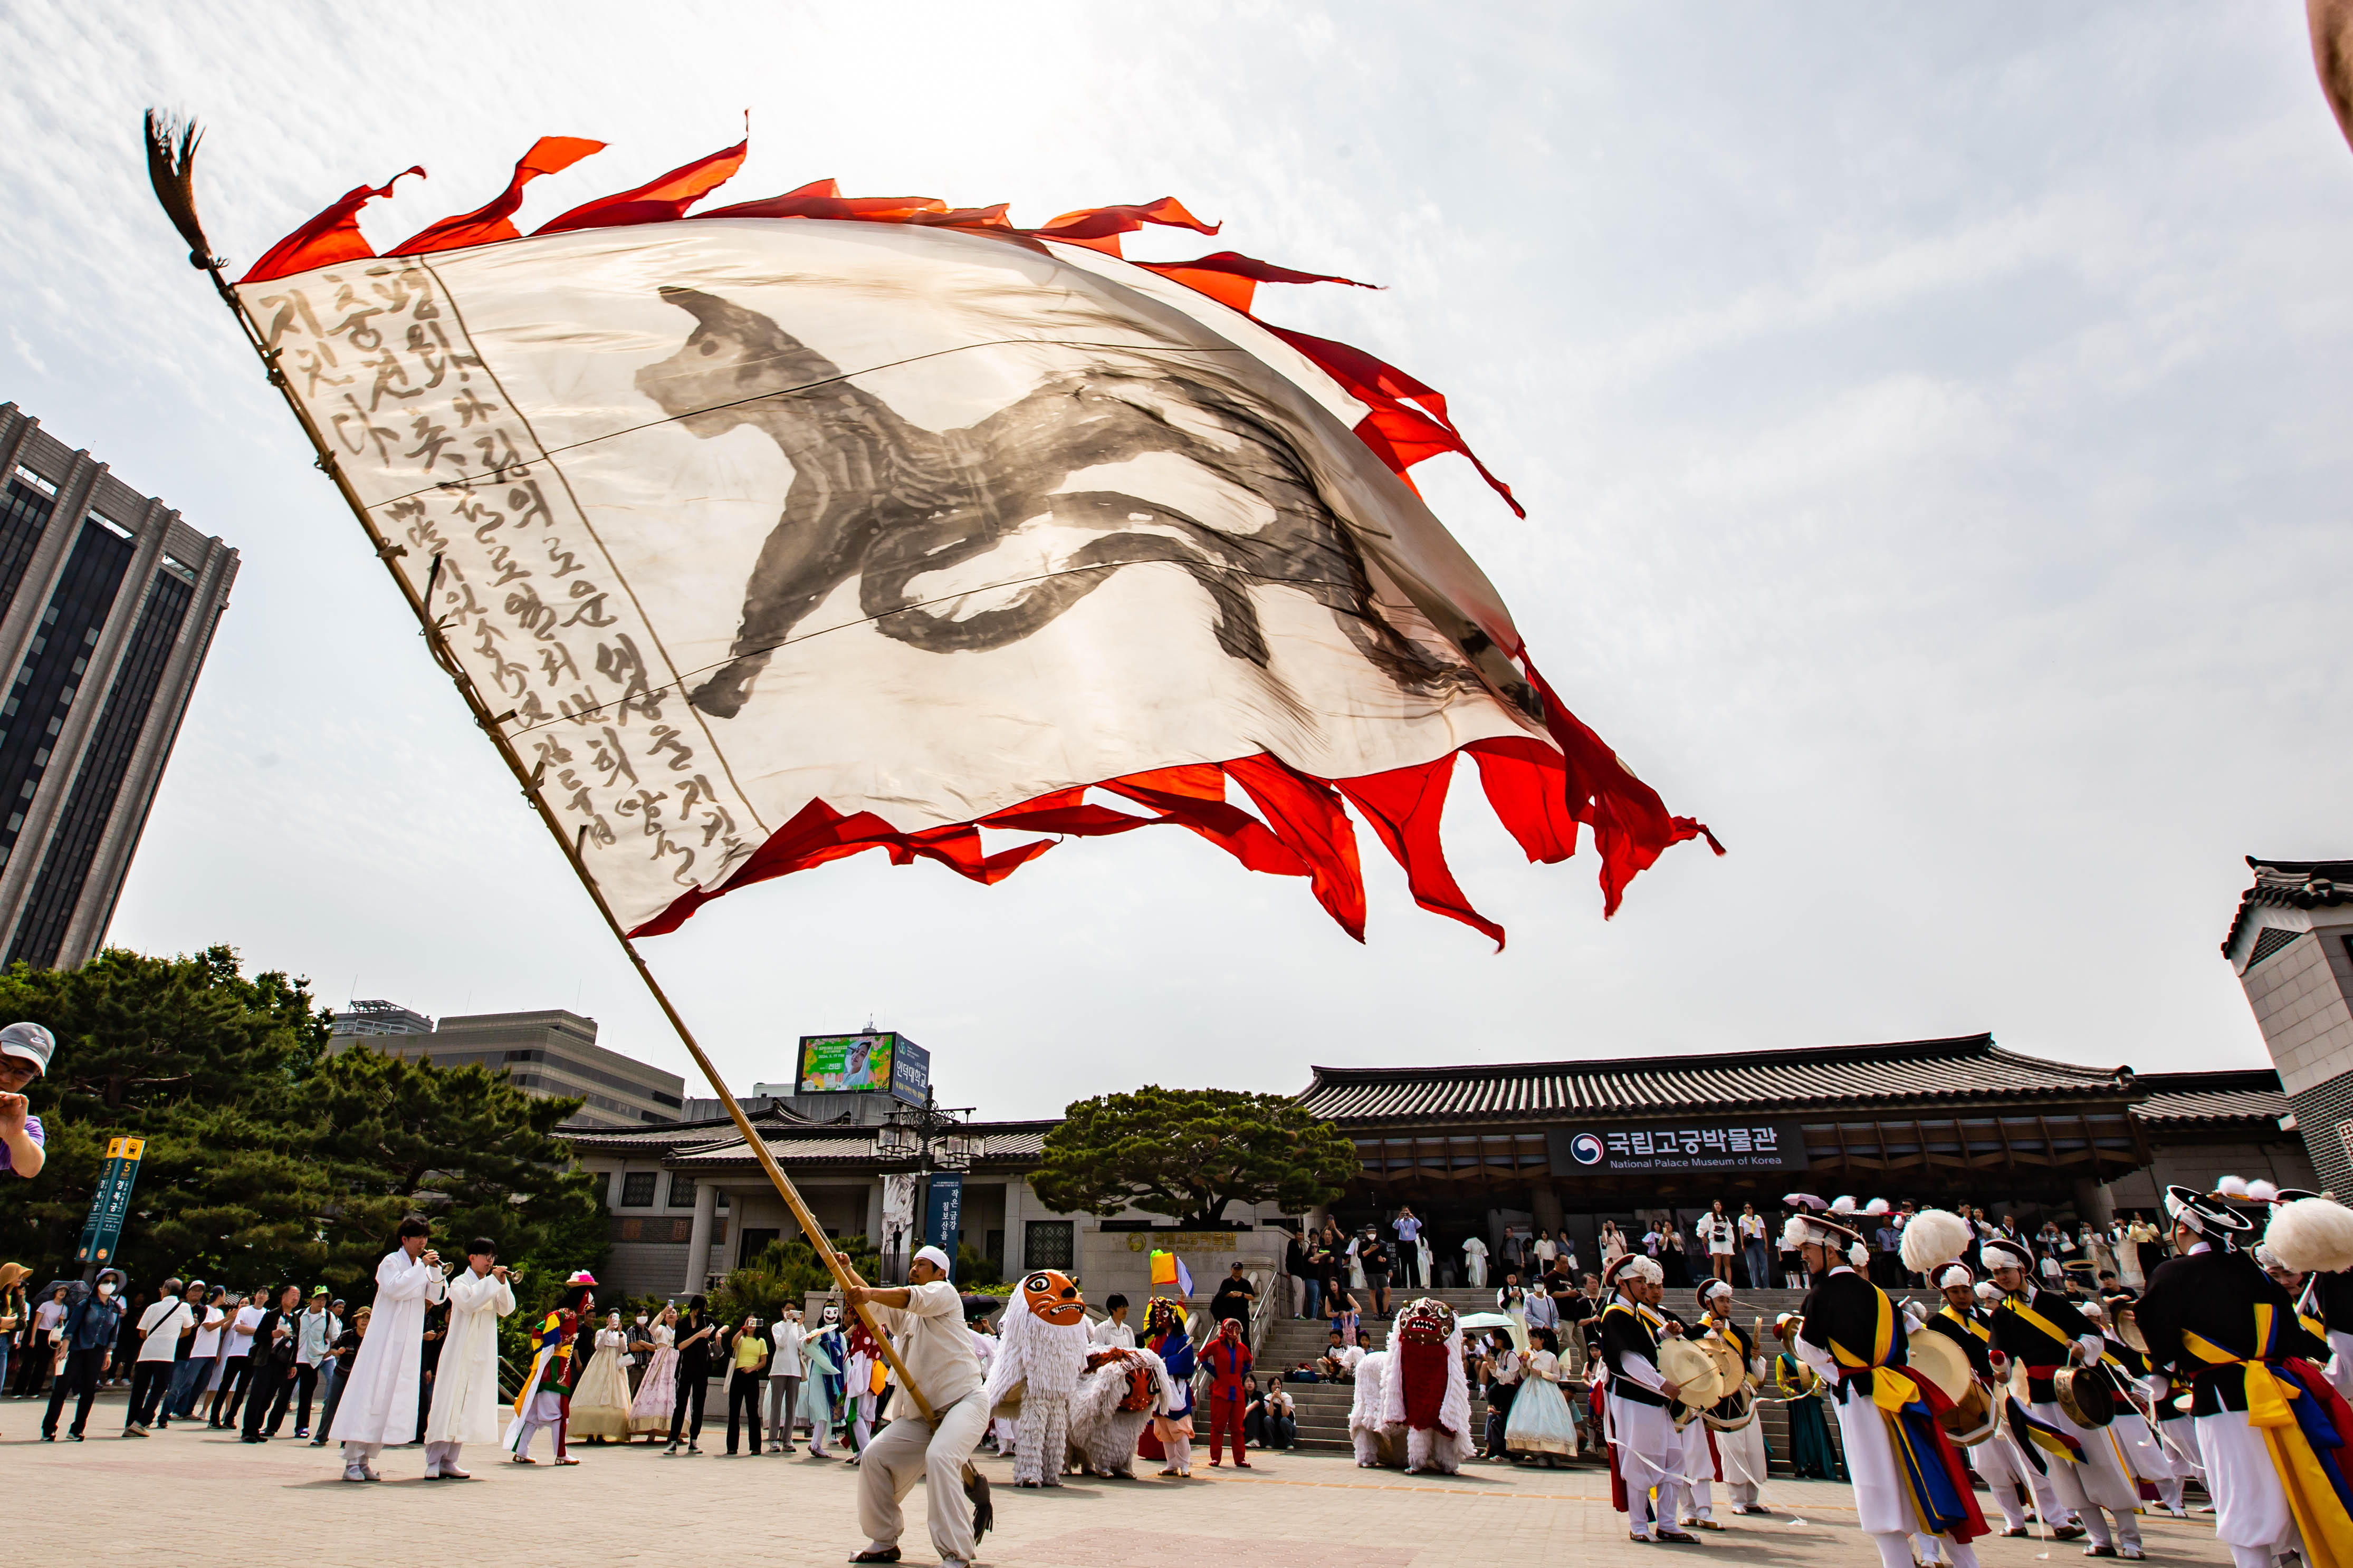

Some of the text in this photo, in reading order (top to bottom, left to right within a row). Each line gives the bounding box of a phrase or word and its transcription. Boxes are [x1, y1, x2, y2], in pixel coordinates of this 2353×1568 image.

[259, 288, 400, 468] 지킨다
[897, 1060, 926, 1089] 인덕대학교
[1608, 1127, 1777, 1156] 국립고궁박물관
[106, 1160, 113, 1171] 5
[123, 1162, 131, 1172] 5
[1610, 1159, 1652, 1169] National
[1654, 1159, 1688, 1167] Palace
[1691, 1158, 1734, 1166] Museum
[1751, 1156, 1782, 1165] Korea
[92, 1179, 106, 1211] 경복궁
[110, 1180, 125, 1212] 경복궁
[949, 1189, 959, 1230] 작은 금강
[941, 1201, 949, 1240] 칠보산을
